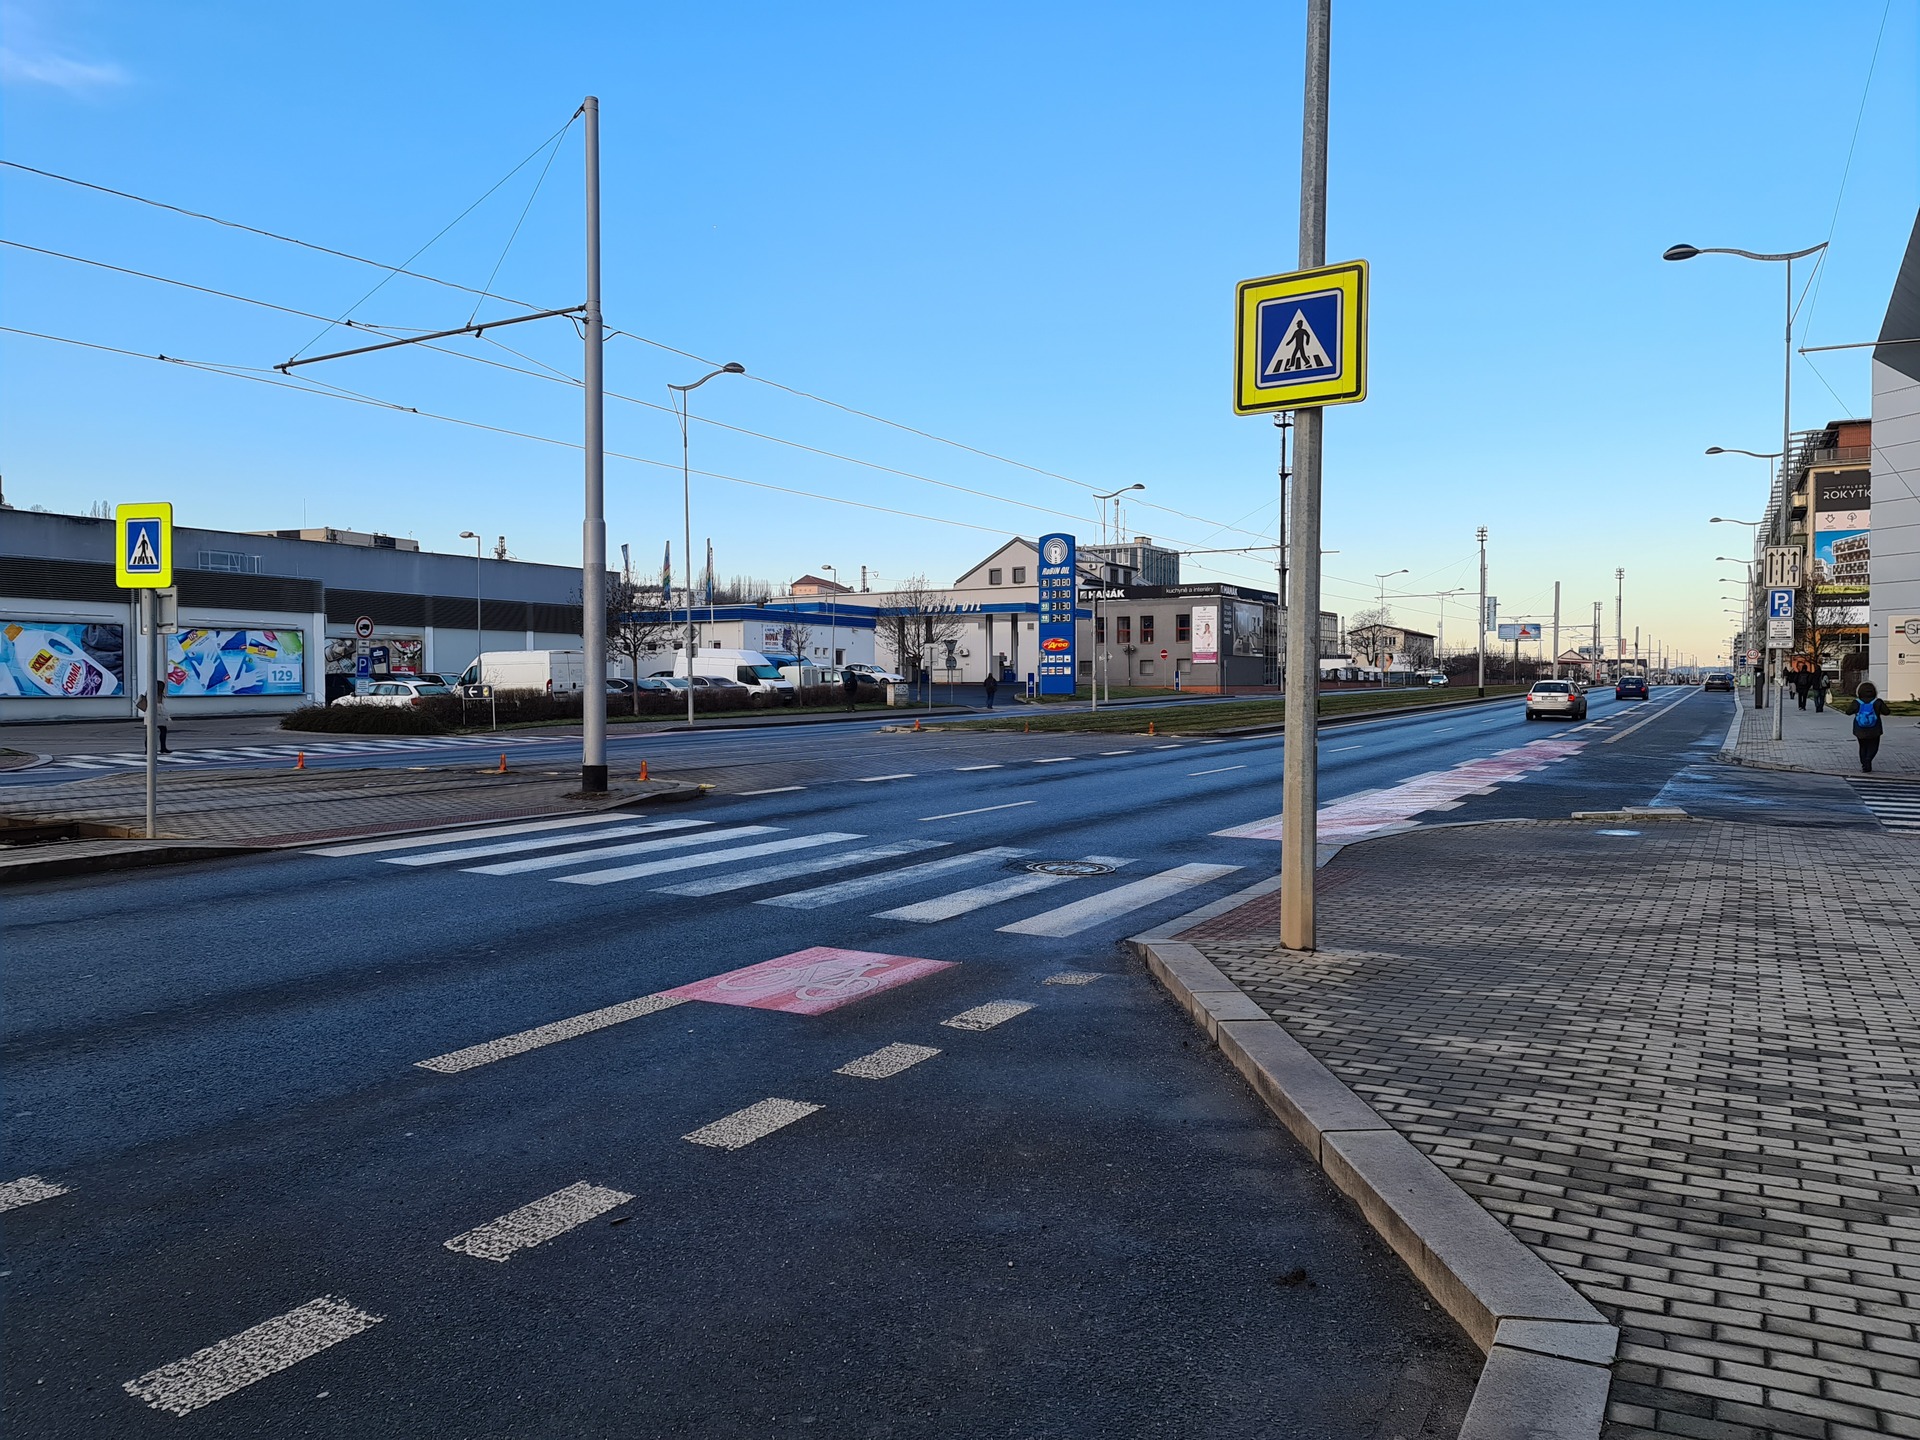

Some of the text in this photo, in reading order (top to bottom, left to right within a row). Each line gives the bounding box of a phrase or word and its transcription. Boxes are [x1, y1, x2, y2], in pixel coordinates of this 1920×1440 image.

[1088, 589, 1125, 599] HANÁK
[1774, 592, 1789, 610] P
[359, 658, 367, 671] P
